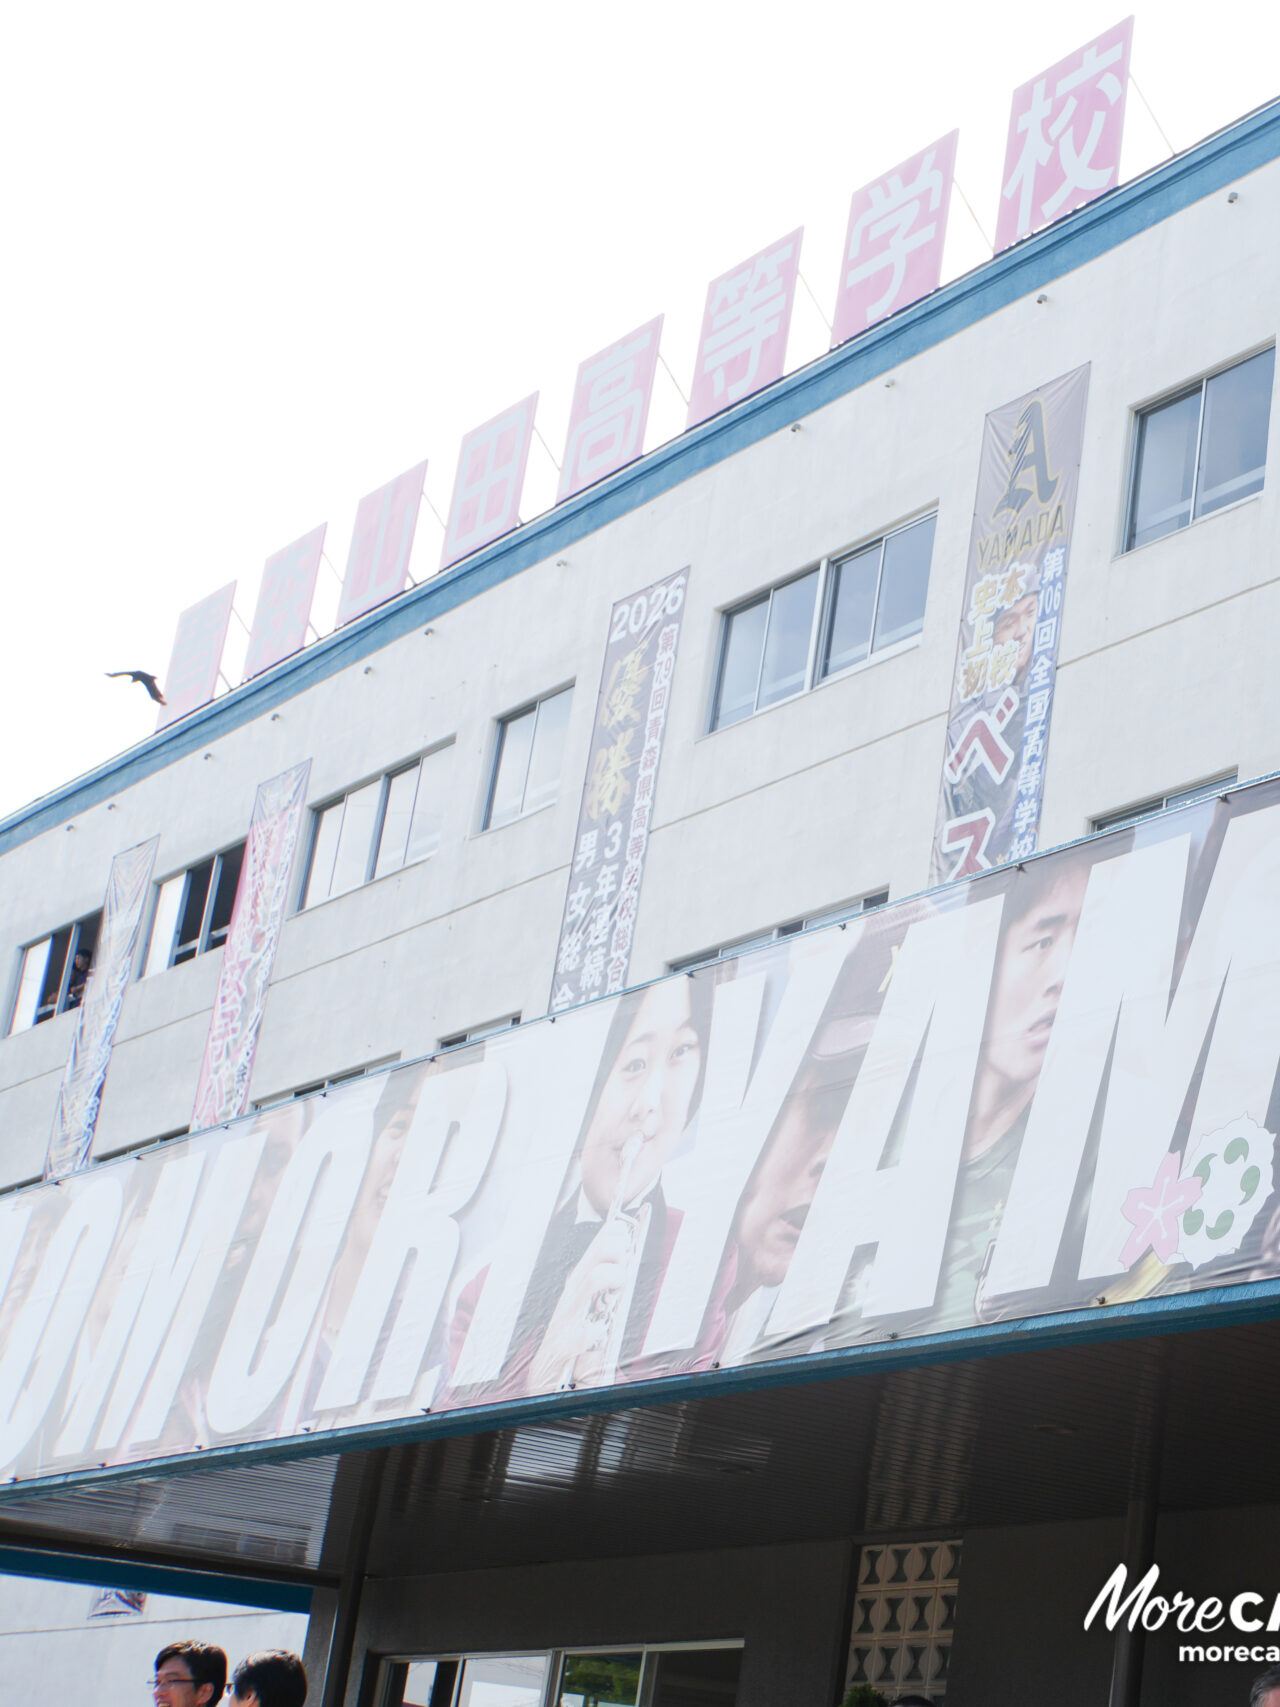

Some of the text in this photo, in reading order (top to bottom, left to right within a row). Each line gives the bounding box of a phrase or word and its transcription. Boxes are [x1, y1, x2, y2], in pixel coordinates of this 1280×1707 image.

[170, 40, 1124, 706] 青森山田高等学校
[976, 503, 1068, 573] YAMADA
[609, 576, 686, 643] 2026
[607, 624, 678, 994] 第79回青森県高等学校総合
[0, 1022, 603, 1467] OMORI
